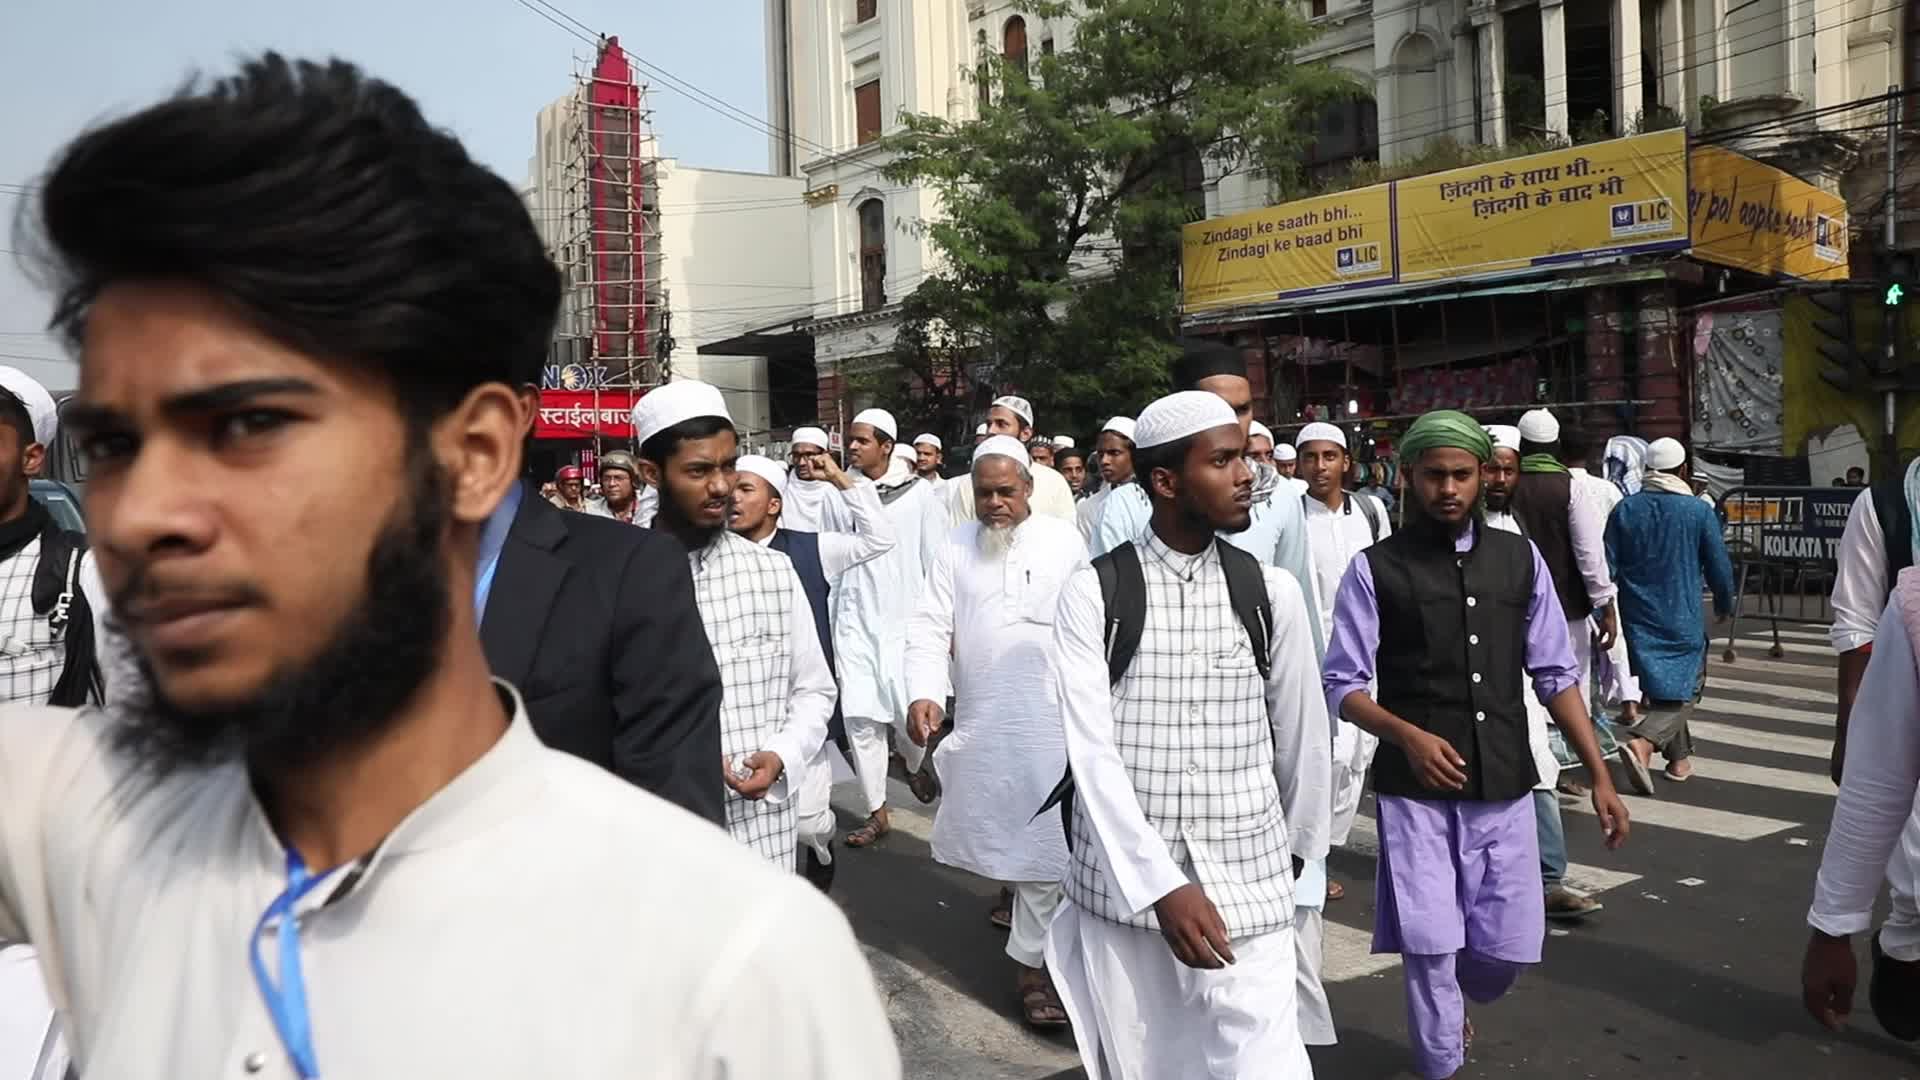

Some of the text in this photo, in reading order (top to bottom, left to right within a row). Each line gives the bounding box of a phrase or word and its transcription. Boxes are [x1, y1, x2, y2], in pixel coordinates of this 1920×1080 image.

[1500, 172, 1516, 190] के
[1520, 166, 1560, 187] साथ
[1535, 188, 1553, 208] के
[1558, 183, 1593, 202] बाद
[1598, 176, 1624, 196] भी
[1638, 202, 1667, 222] LIC
[1203, 224, 1252, 245] Zindagi
[1257, 221, 1273, 235] ke
[1277, 211, 1319, 231] saath
[1323, 205, 1363, 221] bhi...
[1217, 240, 1269, 262] Zindagi
[1274, 237, 1291, 252] ke
[1295, 230, 1333, 248] baad
[1338, 224, 1363, 241] bhi
[1355, 246, 1377, 262] LIC
[1763, 535, 1823, 558] KOLKATA
